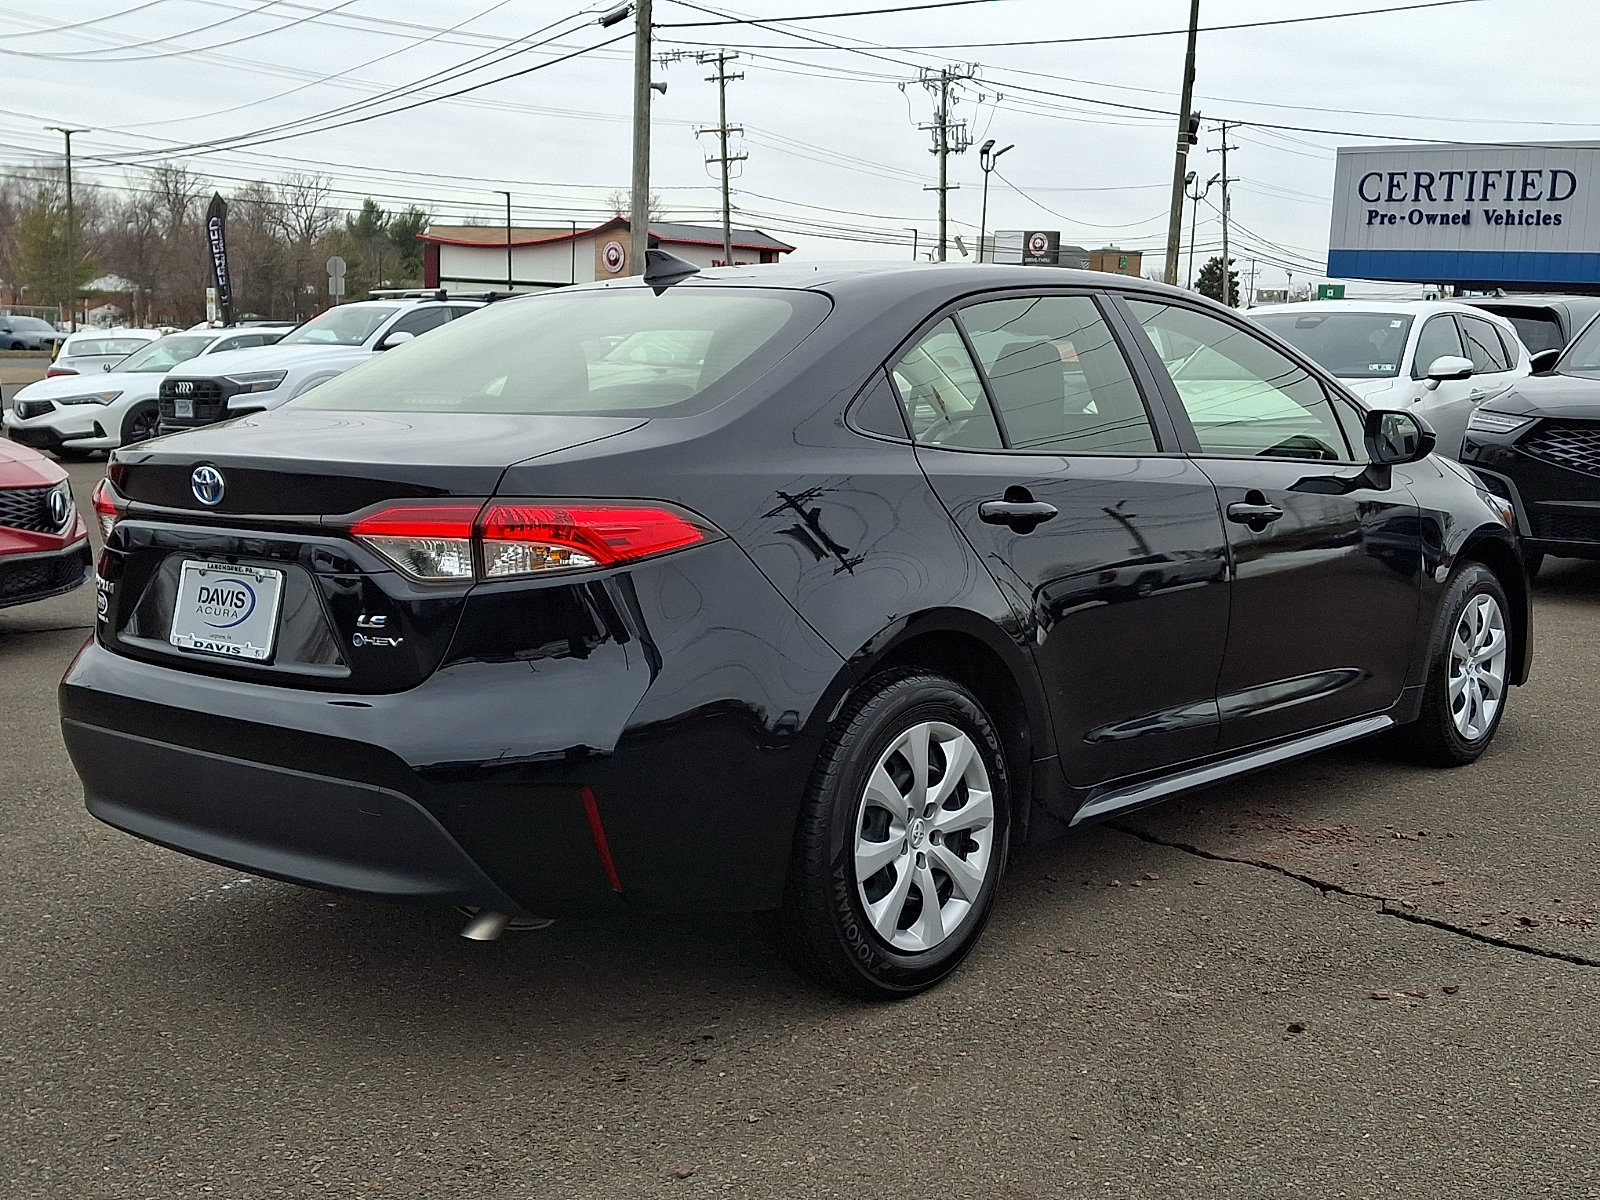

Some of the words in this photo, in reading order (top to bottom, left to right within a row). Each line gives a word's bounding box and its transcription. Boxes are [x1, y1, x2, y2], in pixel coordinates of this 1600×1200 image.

[1358, 169, 1577, 202] CERTIFIED
[1367, 209, 1471, 226] Pre-Owned
[1483, 209, 1562, 226] Vehicles
[198, 587, 246, 609] DAVIS
[196, 605, 239, 619] ACURA
[357, 614, 387, 628] LE
[193, 641, 242, 655] DAVIS
[832, 863, 876, 969] YOKOHAMA
